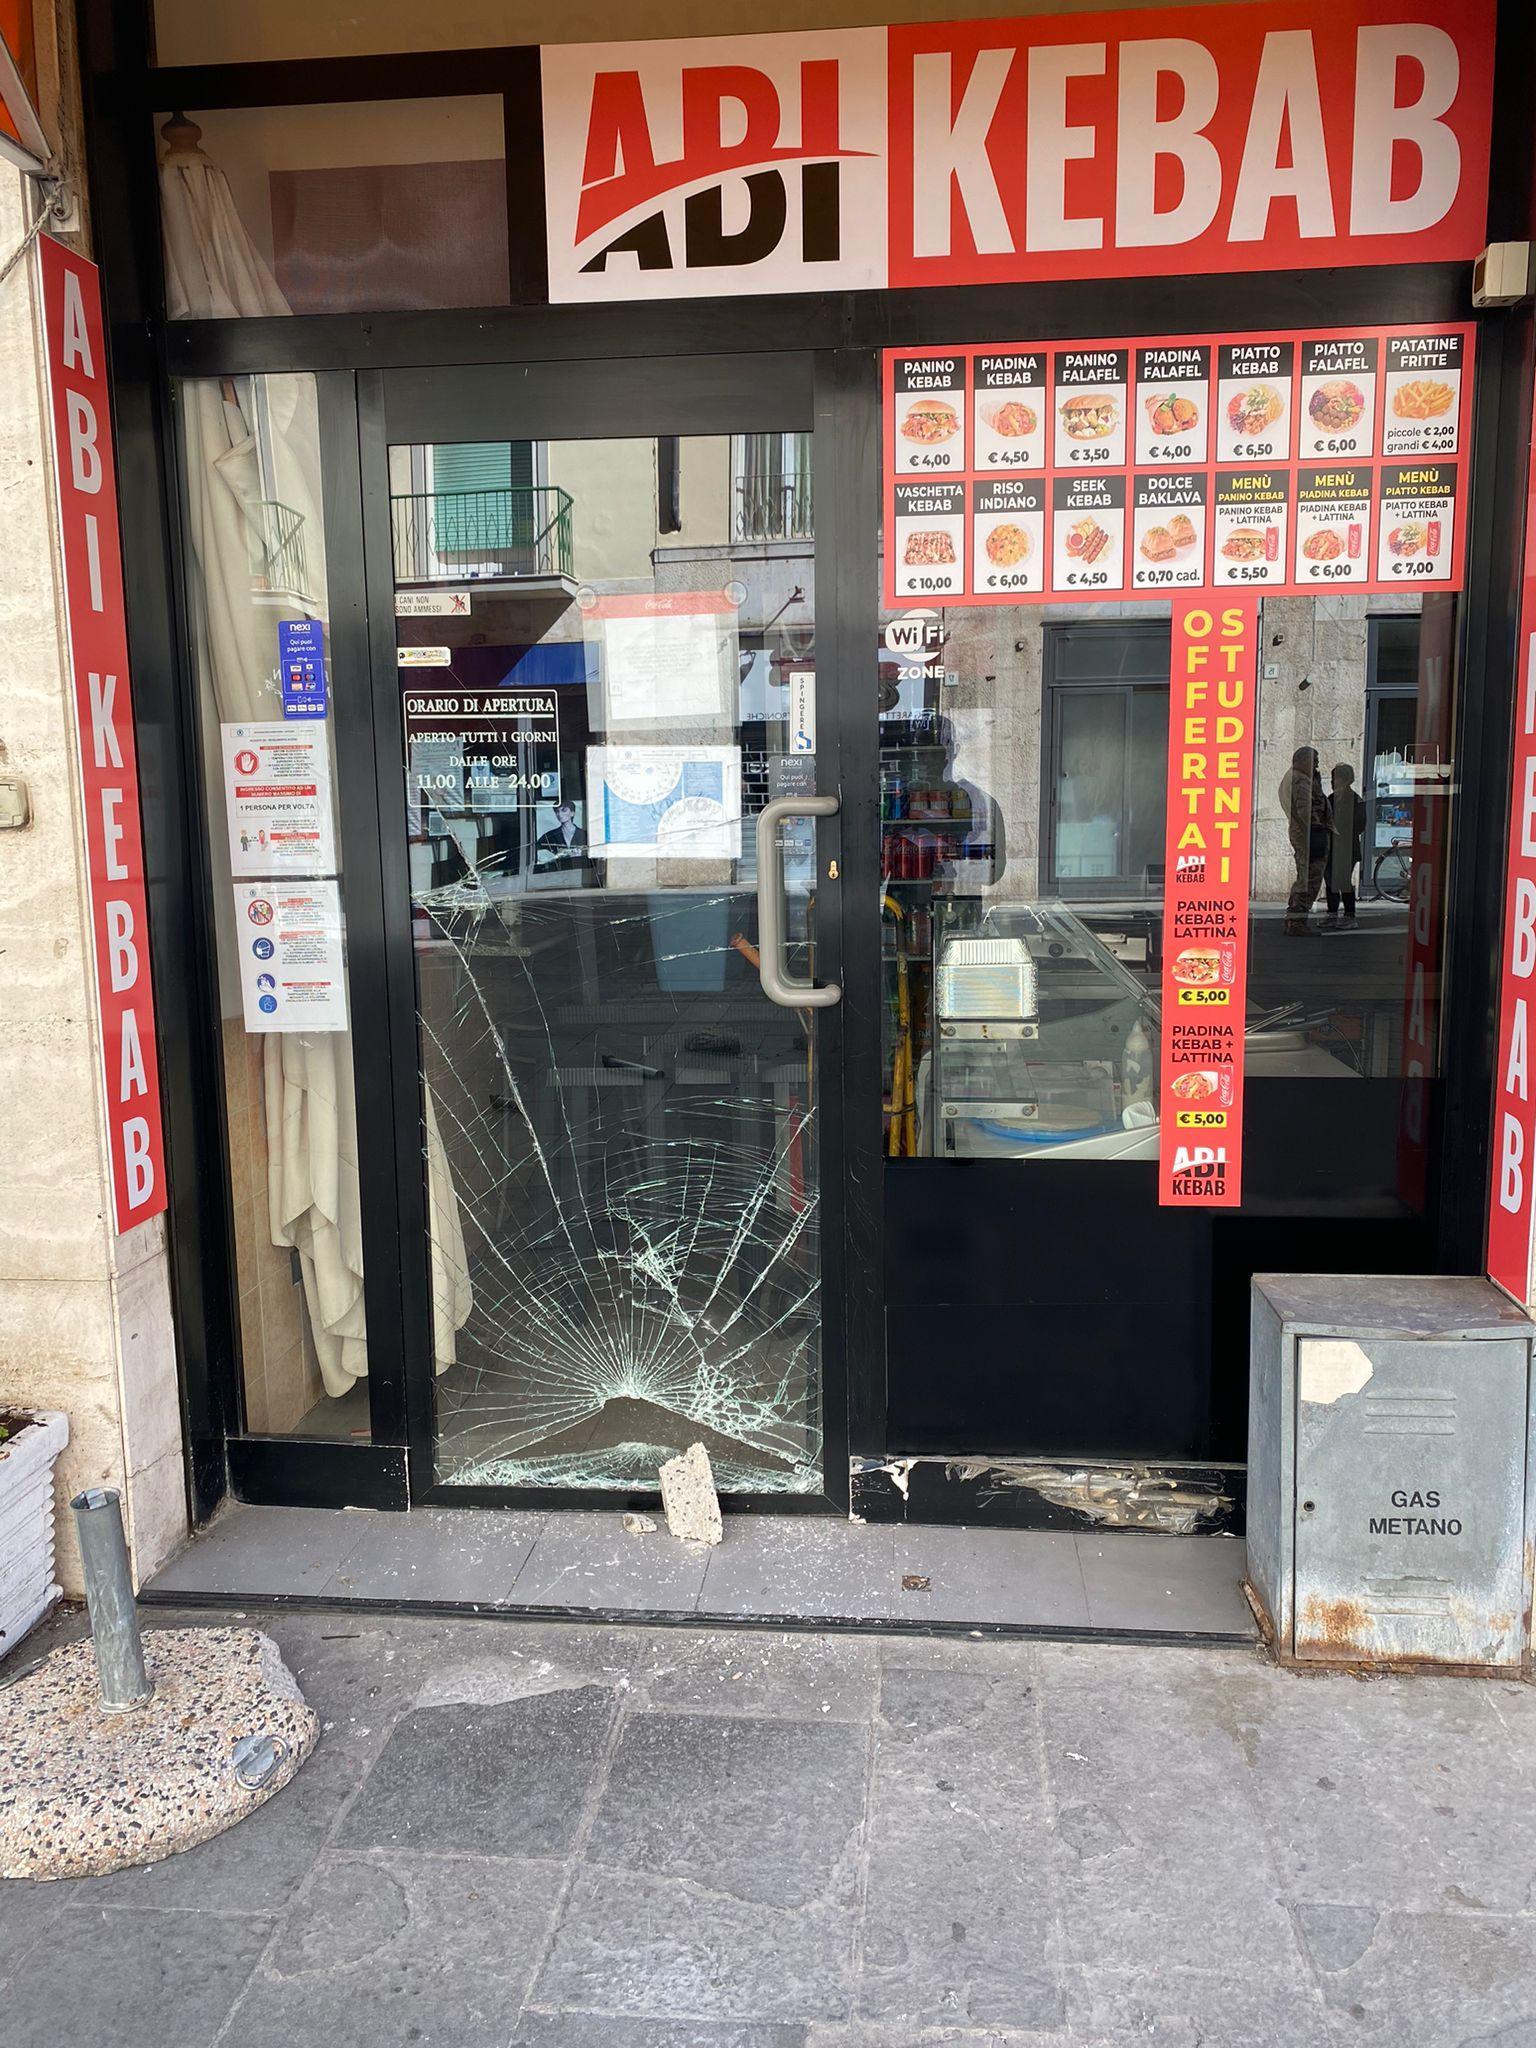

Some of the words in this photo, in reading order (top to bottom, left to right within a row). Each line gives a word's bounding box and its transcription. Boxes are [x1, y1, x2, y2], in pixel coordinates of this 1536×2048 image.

[574, 59, 845, 272] ABI
[911, 22, 1463, 259] KEBAB
[1314, 342, 1364, 356] PIATTO
[1391, 338, 1458, 353] PATATINE
[1065, 353, 1118, 366] PANINO
[1145, 350, 1201, 363] PIADINA
[1231, 346, 1281, 360] PIATTO
[981, 357, 1037, 371] PIADINA
[1309, 357, 1369, 372] FALAFEL
[1400, 354, 1447, 367] FRITTE
[904, 361, 955, 374] PANINO
[1143, 364, 1202, 379] FALAFEL
[1232, 361, 1279, 375] KEBAB
[986, 372, 1032, 386] KEBAB
[1062, 368, 1120, 382] FALAFEL
[907, 375, 951, 389] KEBAB
[1387, 426, 1421, 442] piccole
[1424, 427, 1431, 436] €
[1433, 426, 1454, 437] 2,00
[1149, 446, 1159, 458] €
[1162, 445, 1192, 459] 4,00
[1233, 444, 1243, 456] €
[1246, 444, 1273, 458] 6,50
[1314, 440, 1324, 451] €
[1327, 439, 1357, 453] 6,00
[1387, 440, 1420, 453] grandi
[1421, 440, 1429, 449] €
[1431, 440, 1454, 450] 4,00
[909, 455, 919, 467] €
[921, 454, 950, 467] 4,00
[988, 452, 998, 463] €
[1000, 451, 1029, 464] 4,50
[1069, 449, 1079, 460] €
[1082, 449, 1110, 462] 3,50
[1232, 474, 1272, 489] MENÙ
[1315, 471, 1355, 487] MENÙ
[1399, 468, 1439, 483] MENÙ
[993, 482, 1024, 494] RISO
[1072, 479, 1106, 491] SEEK
[1148, 477, 1193, 489] DOLCE
[896, 485, 964, 498] VASCHETTA
[1218, 493, 1252, 501] PANINO
[1254, 491, 1284, 500] KEBAB
[1300, 490, 1337, 499] PIADINA
[1339, 488, 1369, 497] KEBAB
[1386, 487, 1418, 495] PIATTO
[1420, 485, 1451, 494] KEBAB
[980, 496, 1036, 510] INDIANO
[1067, 494, 1112, 507] KEBAB
[1139, 491, 1201, 505] BAKLAVA
[908, 499, 952, 512] KEBAB
[1219, 506, 1252, 515] PANINO
[1254, 505, 1283, 514] KEBAB
[1300, 504, 1336, 513] PIADINA
[1338, 503, 1367, 511] KEBAB
[1386, 501, 1416, 510] PIATTO
[1419, 500, 1448, 509] KEBAB
[1236, 515, 1272, 524] LATTINA
[1319, 513, 1355, 521] LATTINA
[1402, 510, 1438, 519] LATTINA
[1227, 567, 1237, 579] €
[1241, 567, 1268, 580] 5,50
[1310, 565, 1320, 577] €
[1323, 564, 1351, 578] 6,00
[1392, 563, 1402, 574] €
[1405, 562, 1433, 576] 7,00
[987, 575, 996, 586] €
[1000, 574, 1028, 588] 6,00
[1066, 573, 1076, 584] €
[1080, 572, 1107, 586] 4,50
[1136, 571, 1145, 582] €
[1147, 570, 1173, 584] 0,70
[1176, 569, 1200, 581] cad.
[907, 578, 916, 589] €
[919, 577, 952, 591] 10,00
[400, 596, 413, 604] CANI
[416, 596, 429, 604] NON
[289, 623, 311, 632] nexi
[897, 665, 945, 680] ZONE
[407, 699, 458, 713] ORARIO
[463, 699, 478, 712] DI
[483, 698, 555, 713] APERTURA
[1177, 609, 1213, 850] OFFERTA
[63, 268, 103, 613] ABI
[88, 672, 155, 1211] KEBAB
[408, 732, 455, 743] APERTO
[460, 731, 497, 743] TUTTI
[502, 731, 507, 743] I
[511, 731, 557, 742] GIORNI
[1214, 608, 1245, 884] STUDENTI
[449, 756, 488, 767] DALLE
[491, 755, 517, 767] ORE
[780, 758, 803, 767] nexi
[417, 774, 456, 789] 11,00
[465, 776, 500, 788] ALLE
[508, 773, 551, 789] 24,00
[1176, 855, 1206, 873] ABI
[1176, 874, 1205, 883] KEBAB
[1177, 900, 1235, 912] PANINO
[1174, 914, 1225, 925] KEBAB
[1174, 927, 1237, 938] LATTINA
[1181, 991, 1192, 1001] €
[1196, 991, 1227, 1003] 5,00
[1172, 1025, 1234, 1037] PIADINA
[1171, 1039, 1222, 1050] KEBAB
[1171, 1052, 1234, 1063] LATTINA
[1179, 1113, 1190, 1124] €
[1194, 1113, 1224, 1126] 5,00
[1172, 1146, 1227, 1178] ABI
[1172, 1179, 1226, 1196] KEBAB
[1391, 1490, 1441, 1508] GAS
[1369, 1518, 1462, 1535] METANO
